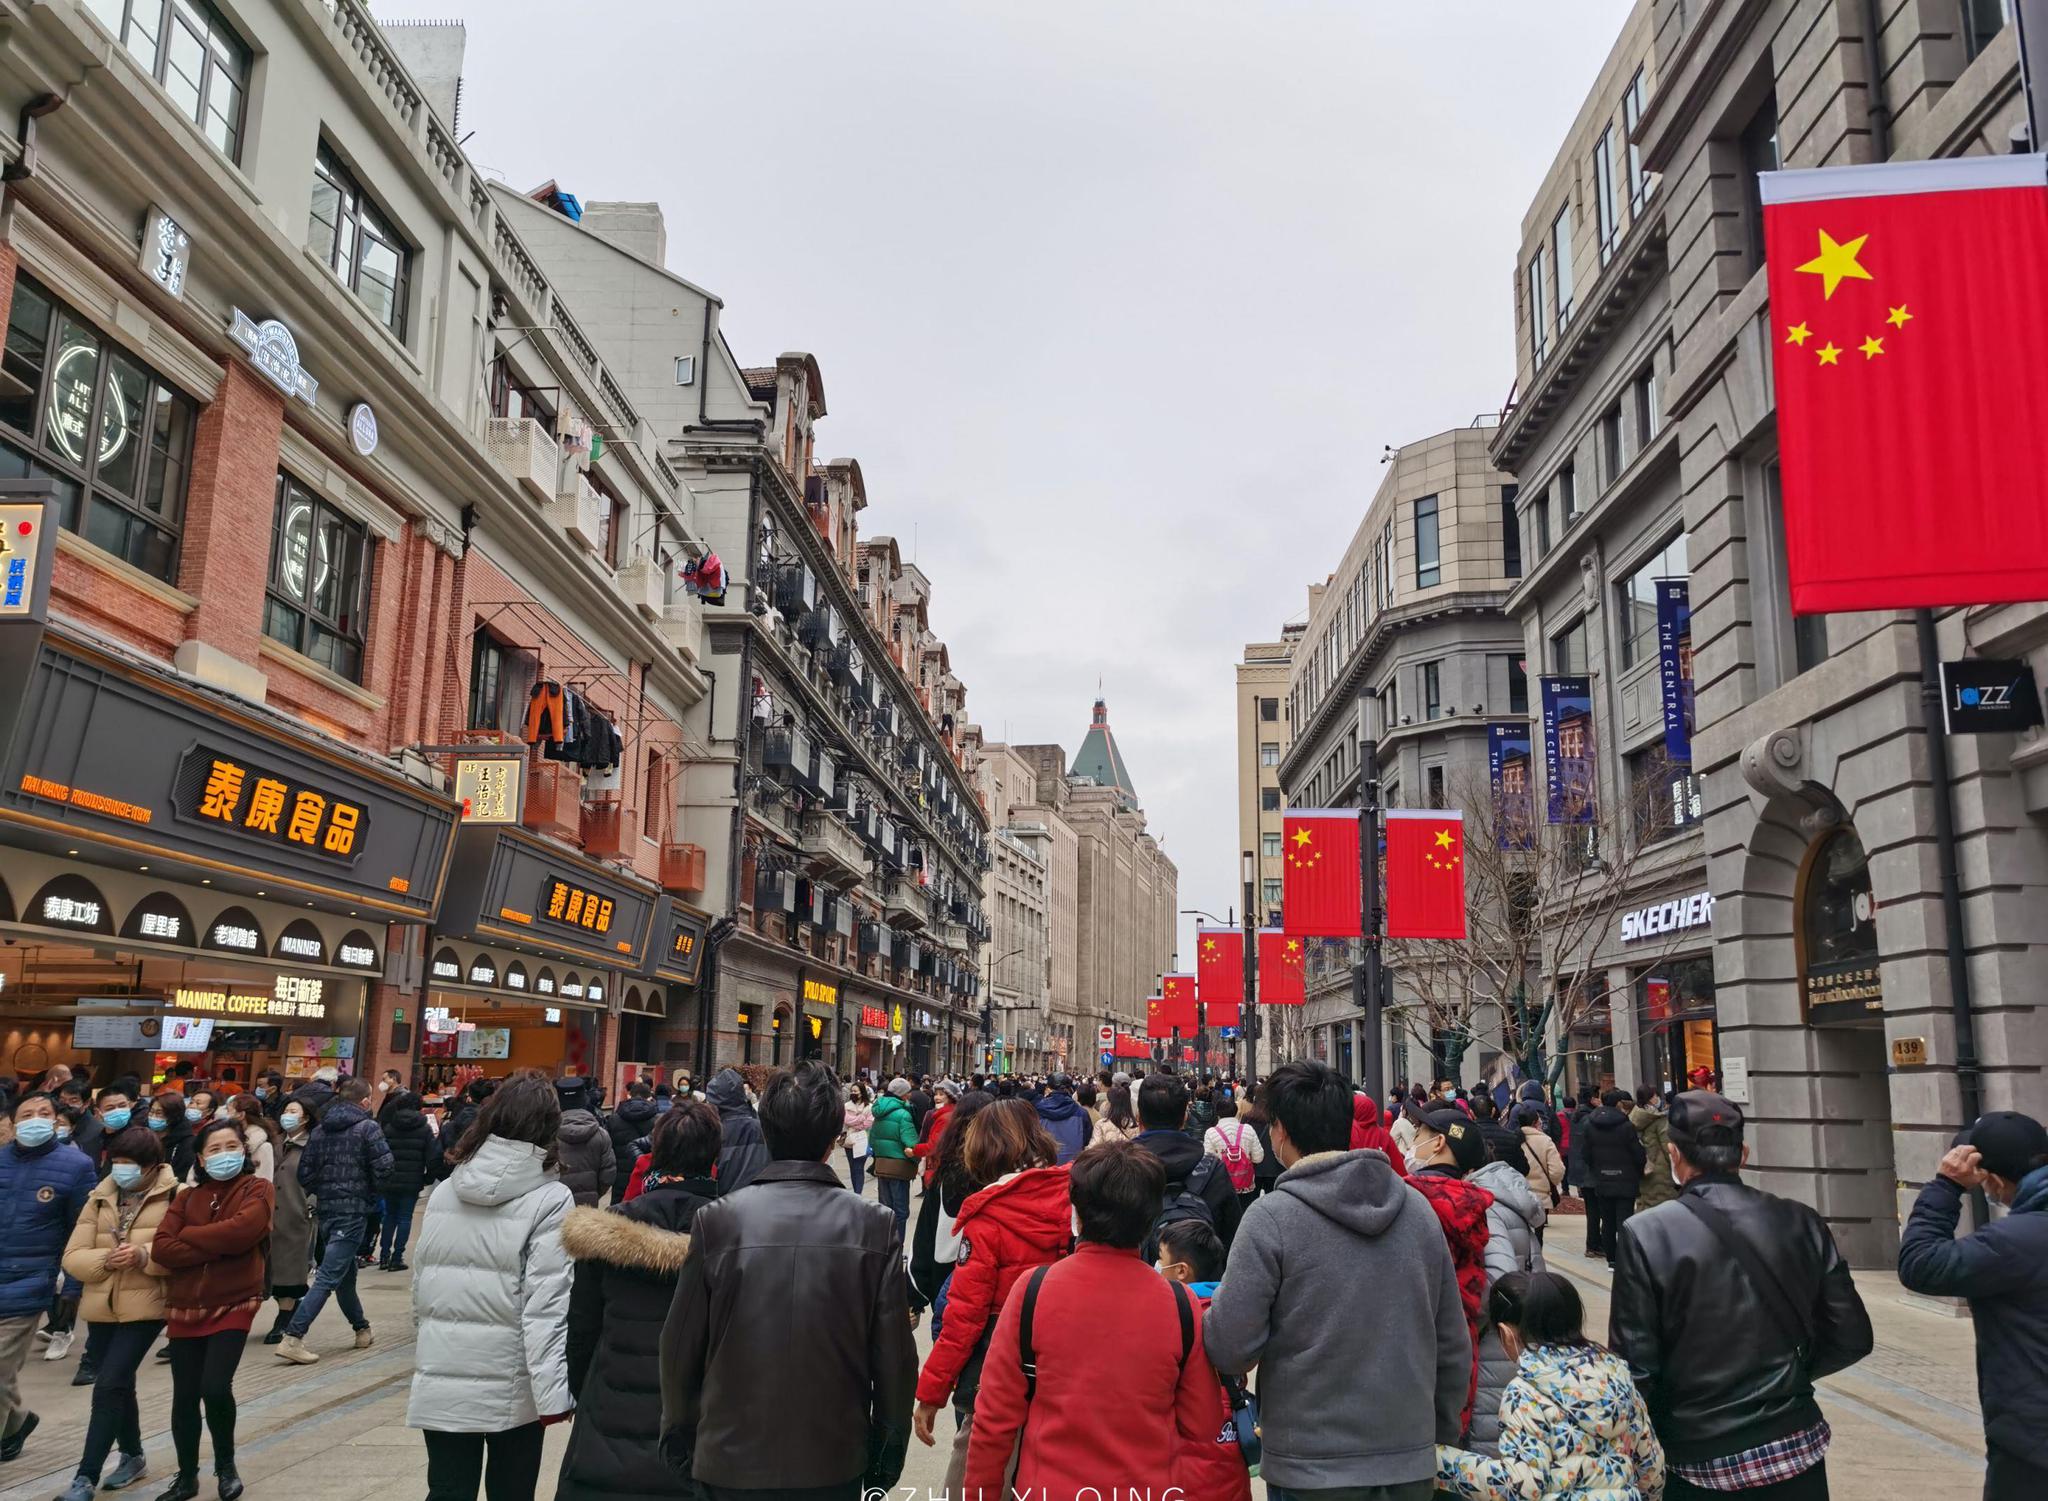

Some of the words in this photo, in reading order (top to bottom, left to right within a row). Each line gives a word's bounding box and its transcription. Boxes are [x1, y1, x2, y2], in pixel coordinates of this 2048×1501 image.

[1661, 622, 1673, 651] THE
[1663, 659, 1678, 730] CENTRAL
[1953, 683, 2012, 711] jazz
[1545, 710, 1554, 734] THE
[1490, 751, 1499, 773] THE
[1547, 741, 1558, 798] CENTRAL
[199, 760, 360, 856] 泰康食品
[44, 896, 100, 926] 泰康工坊
[548, 882, 613, 933] 泰康食品
[140, 913, 180, 938] 屋里香
[214, 924, 258, 950] 老城隍庙
[281, 936, 321, 957] MANNER
[340, 945, 374, 966] 每日新鲜
[176, 989, 226, 1012] MANNER
[228, 995, 268, 1015] COFFEE
[274, 975, 323, 1004] 每日新鲜
[804, 980, 819, 1001] POLO
[819, 984, 836, 1005] SPORT
[267, 1001, 296, 1017] 特色果汁
[1898, 1041, 1918, 1056] 139
